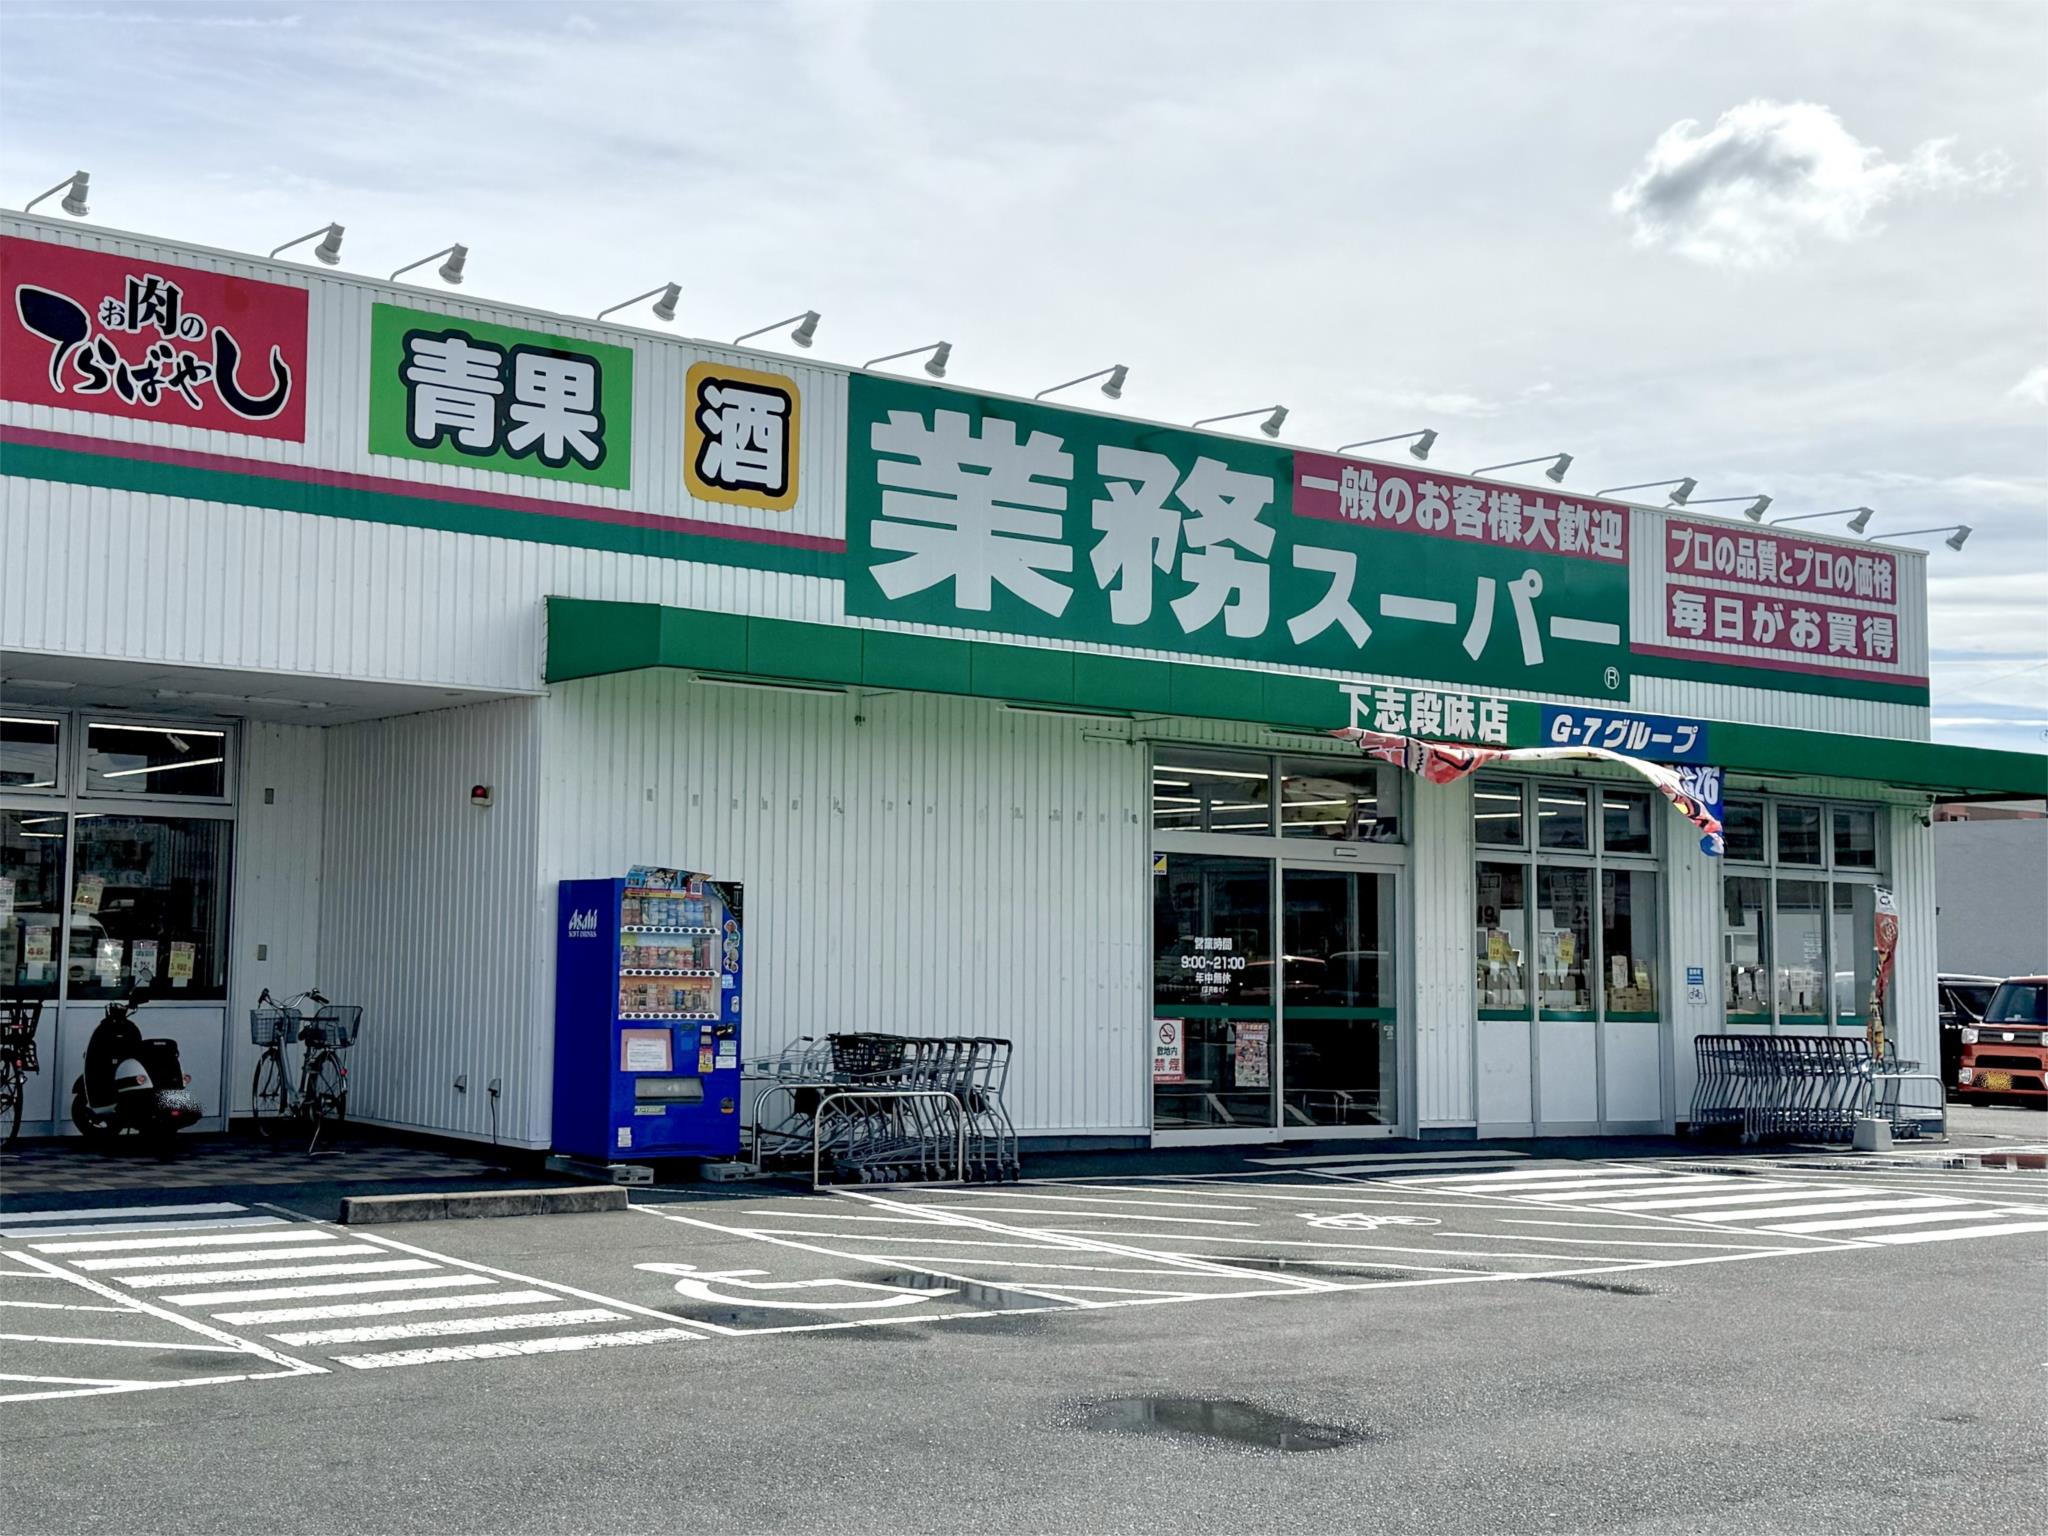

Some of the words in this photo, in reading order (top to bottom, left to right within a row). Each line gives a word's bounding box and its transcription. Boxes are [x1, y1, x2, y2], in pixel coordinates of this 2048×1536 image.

[100, 274, 205, 341] お肉の
[403, 333, 603, 468] 青果
[699, 381, 789, 495] 酒
[868, 409, 1621, 666] 業務スーパー
[1301, 465, 1625, 561] 一般のお客様大歓迎
[1671, 526, 1895, 601] プロの品質とプロの価格
[1671, 589, 1896, 659] 毎日がお買得
[1339, 684, 1508, 744] 下志段味店
[1551, 713, 1699, 754] G-7グループ
[568, 909, 598, 930] Asahi
[1195, 971, 1232, 985] 年中無休
